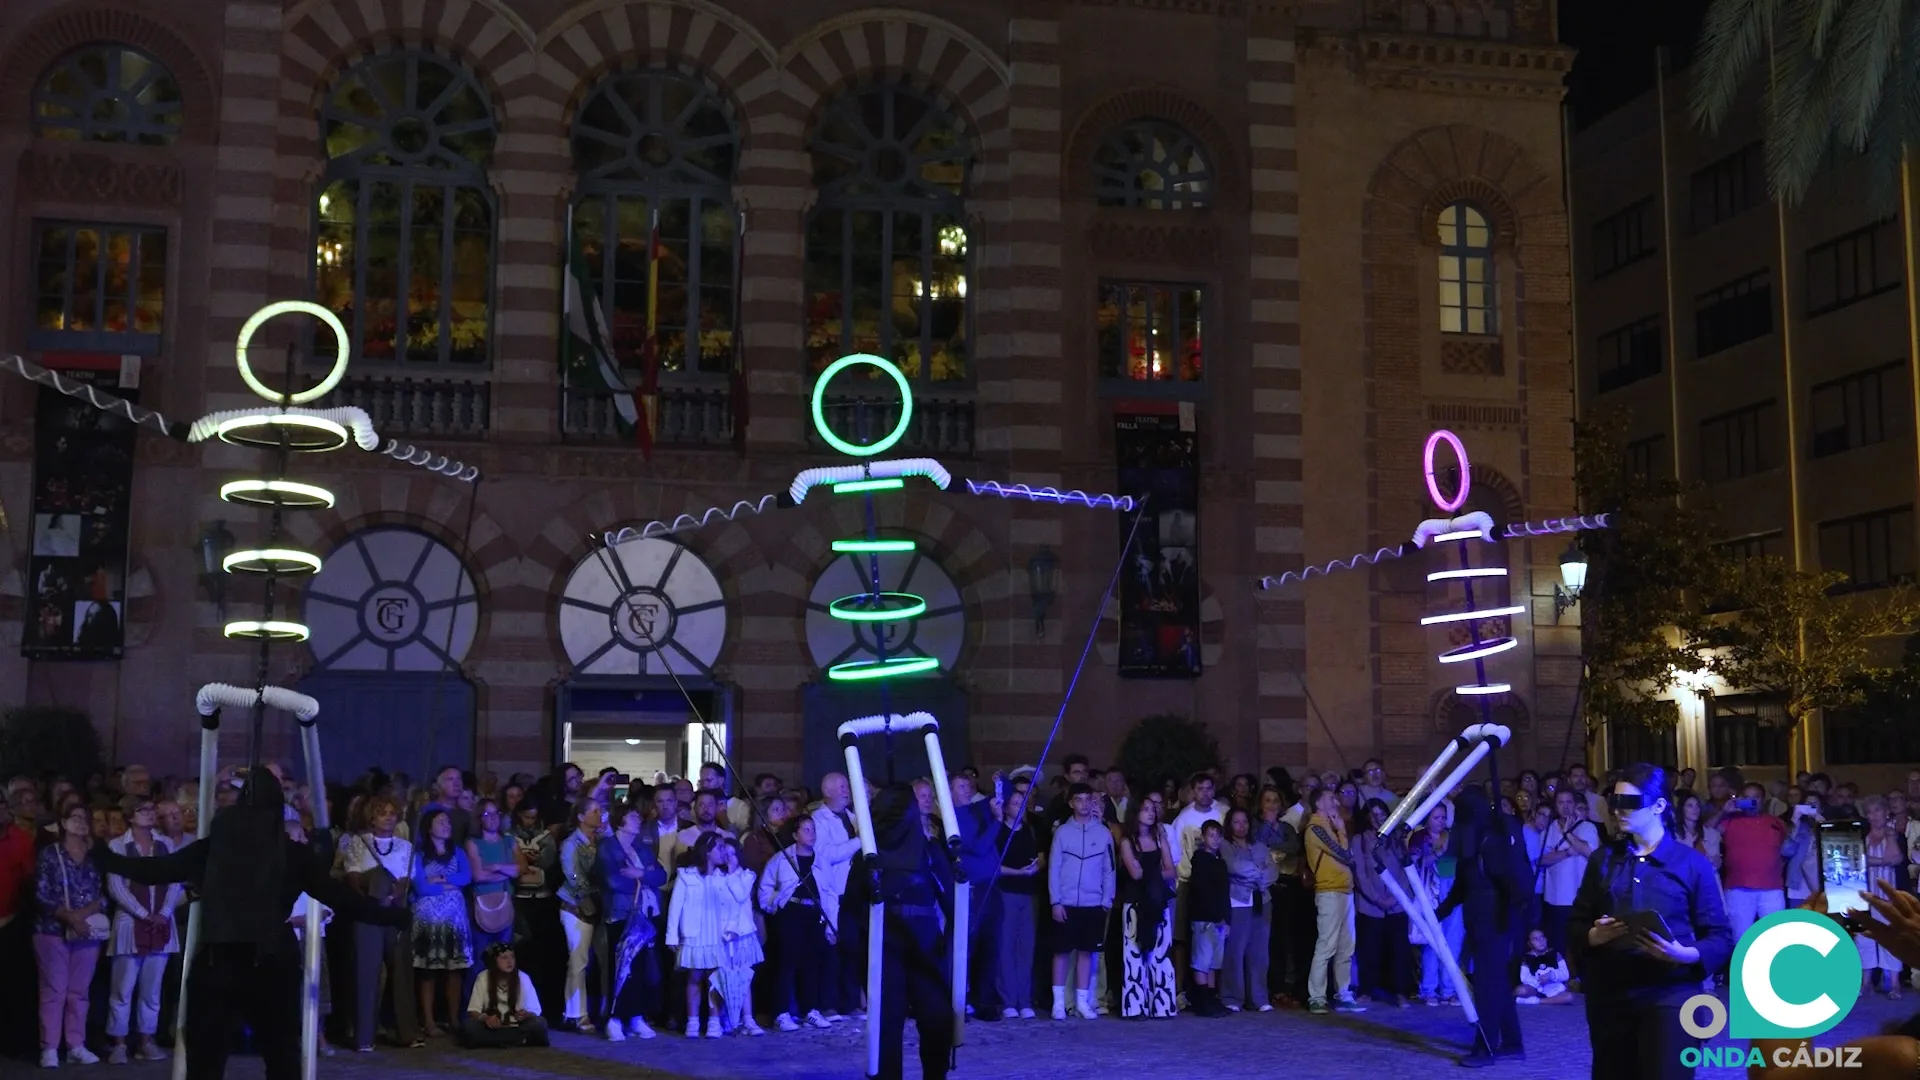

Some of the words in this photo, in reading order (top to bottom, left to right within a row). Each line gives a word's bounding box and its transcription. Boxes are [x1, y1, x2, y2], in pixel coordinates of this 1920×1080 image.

[65, 370, 96, 380] TEATRO
[1134, 416, 1160, 425] TEATRO
[1116, 421, 1139, 430] FALLA
